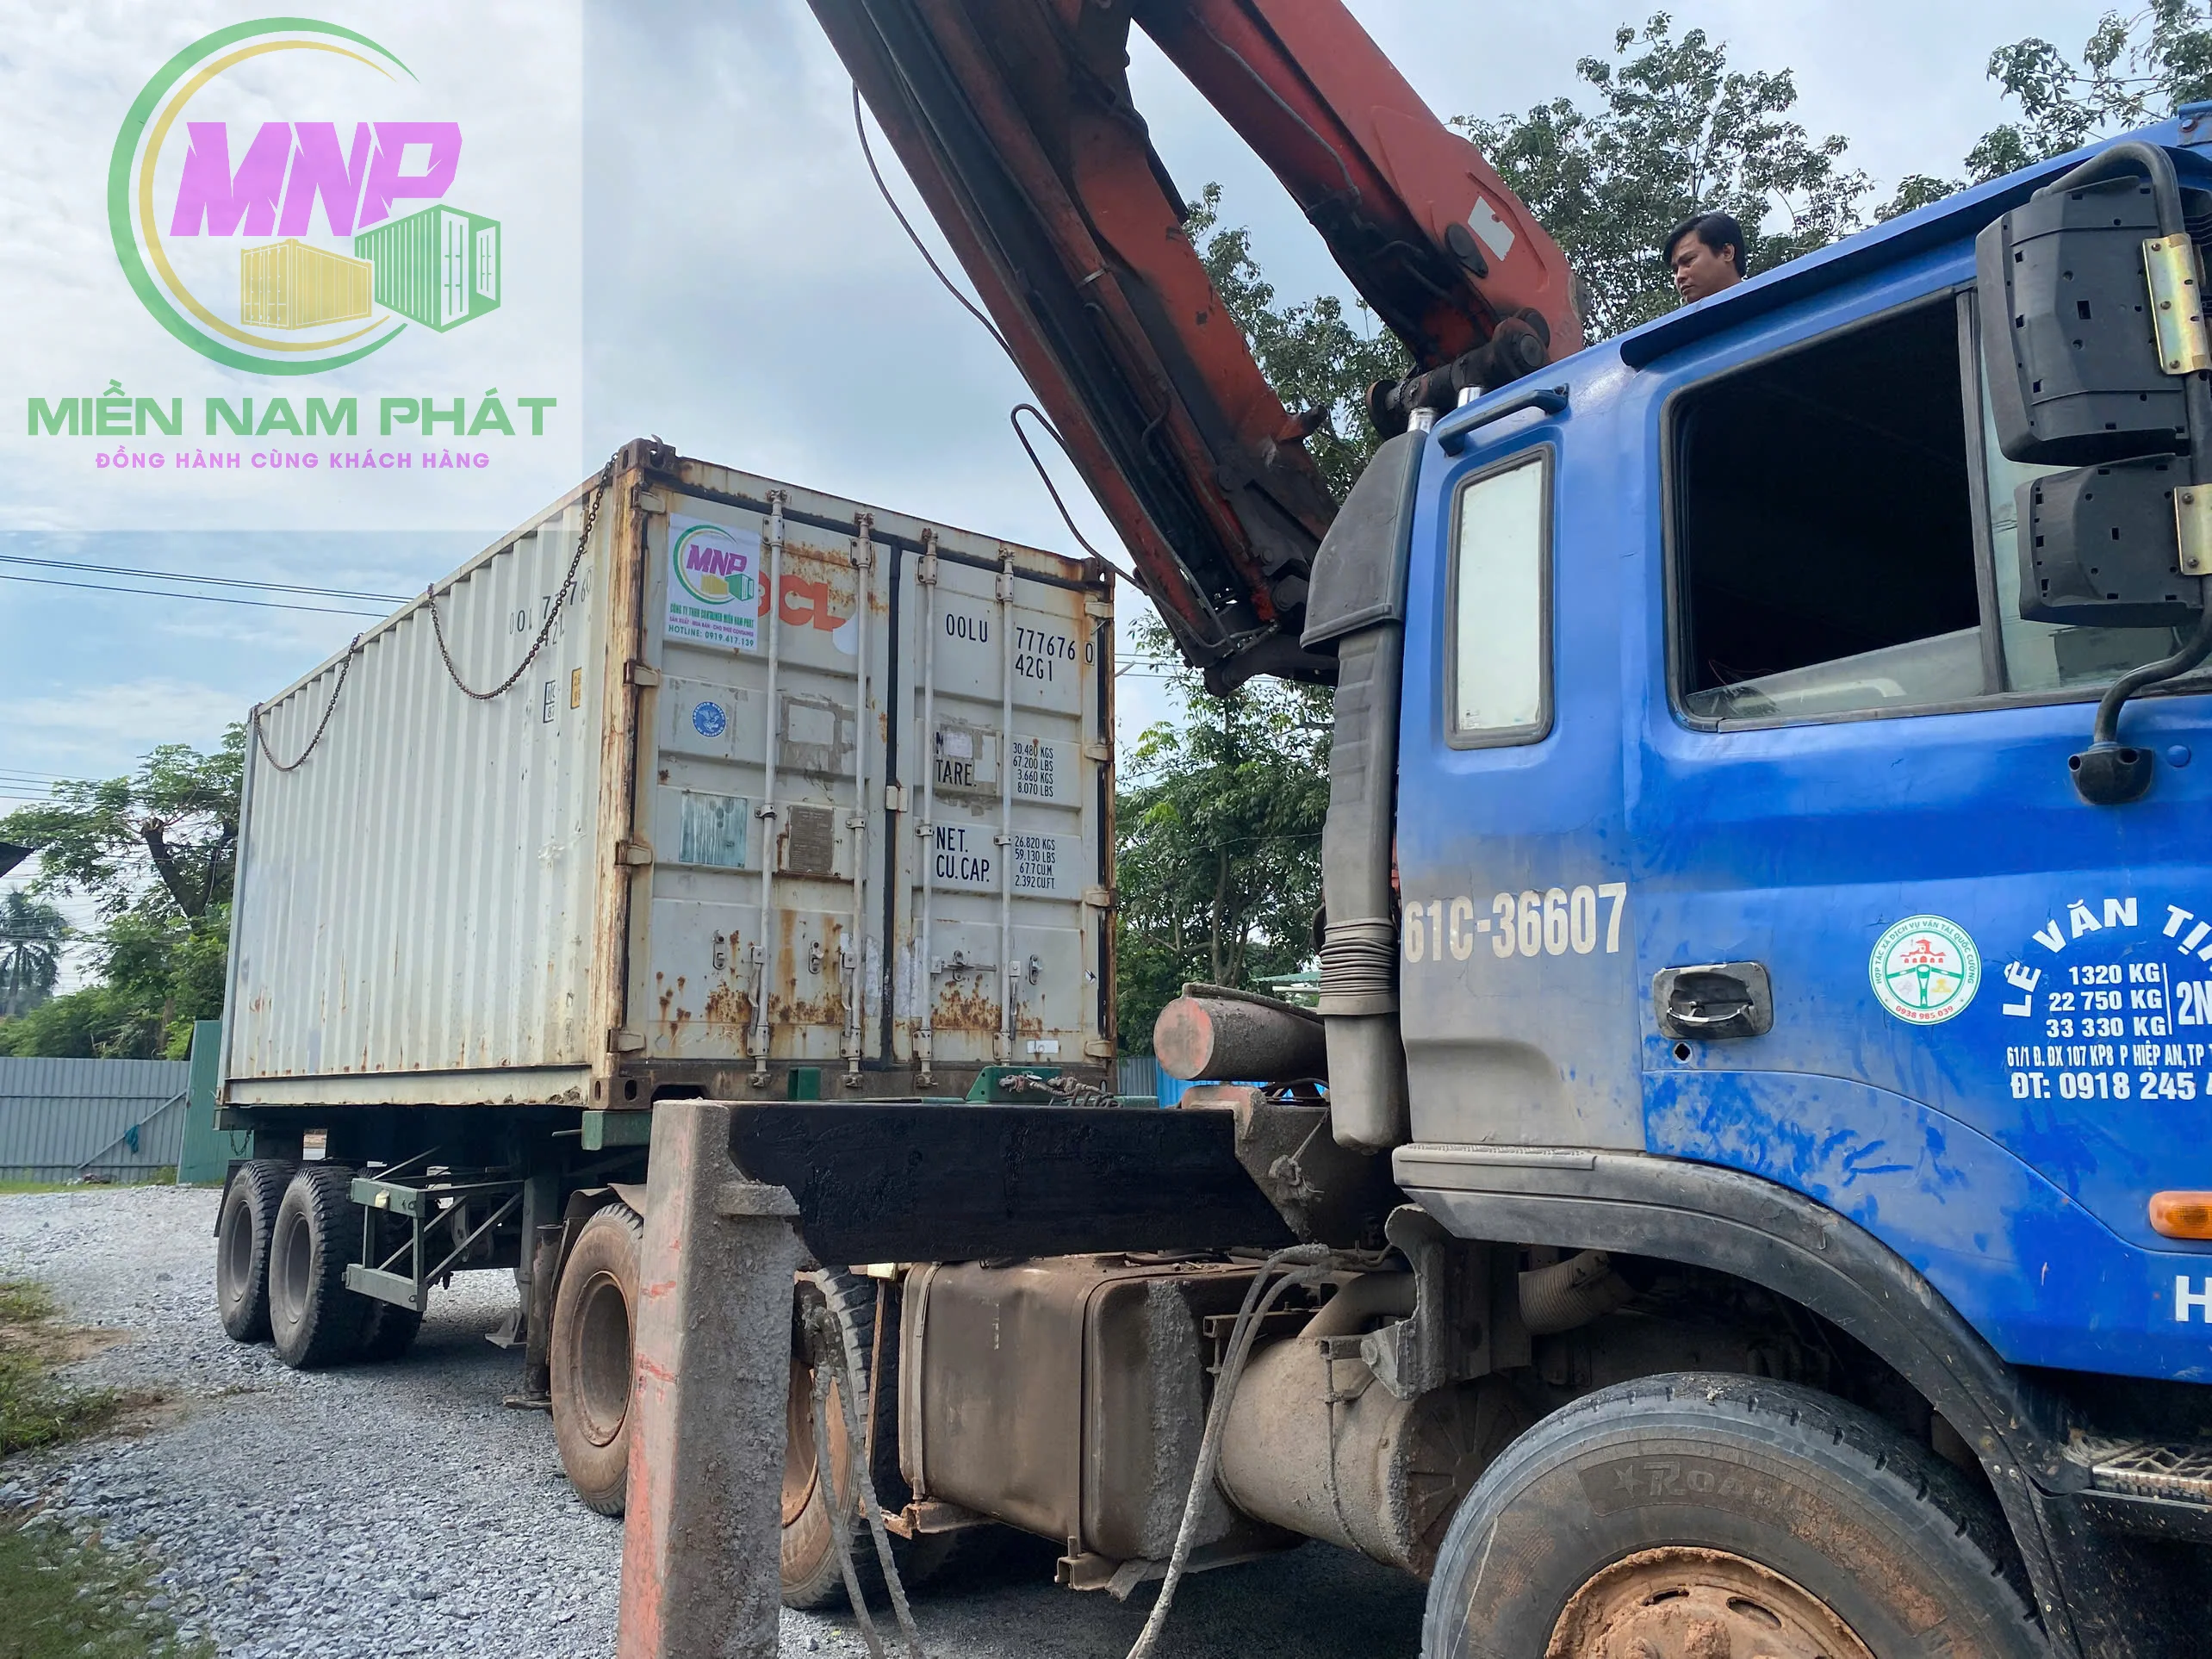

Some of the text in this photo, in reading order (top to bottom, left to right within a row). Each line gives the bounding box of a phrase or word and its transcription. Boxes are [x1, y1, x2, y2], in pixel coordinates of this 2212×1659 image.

[687, 544, 747, 575] MNP
[668, 624, 702, 637] HOTLINE:
[947, 614, 1093, 663] OOLU 777676 0
[1016, 655, 1053, 681] 42G1
[1014, 743, 1053, 759] 30.480 KGS
[936, 760, 977, 786] TARE.
[1014, 756, 1053, 772] 67.200 LBS
[1018, 769, 1053, 785] 3.660 KGS
[1018, 782, 1053, 798] 8.070 LBS
[937, 827, 968, 853] NET.
[1016, 836, 1055, 851] 26.820 KGS
[1016, 848, 1055, 864] 59.130 LBS
[1016, 875, 1035, 888] 2.392
[1404, 882, 1627, 963] 61C-36607
[1875, 950, 1884, 965] TÁC
[2003, 898, 2212, 1017] LÊ VĂN TỊ
[2069, 963, 2160, 985] 1320 KG
[1896, 1005, 1917, 1019] 0938
[1938, 1005, 1954, 1016] 039
[2049, 992, 2075, 1012] 22
[2081, 991, 2122, 1011] 750
[2131, 990, 2162, 1010] KG
[2047, 1016, 2166, 1038] 33 330 KG
[2007, 1046, 2030, 1067] 61/1
[2067, 1045, 2087, 1067] 107
[2090, 1044, 2115, 1067] KP8
[2120, 1044, 2128, 1066] P
[2133, 1041, 2161, 1071] HIỆP
[2010, 1072, 2051, 1099] ĐT:
[2060, 1072, 2131, 1100] 0918
[2140, 1072, 2196, 1100] 245
